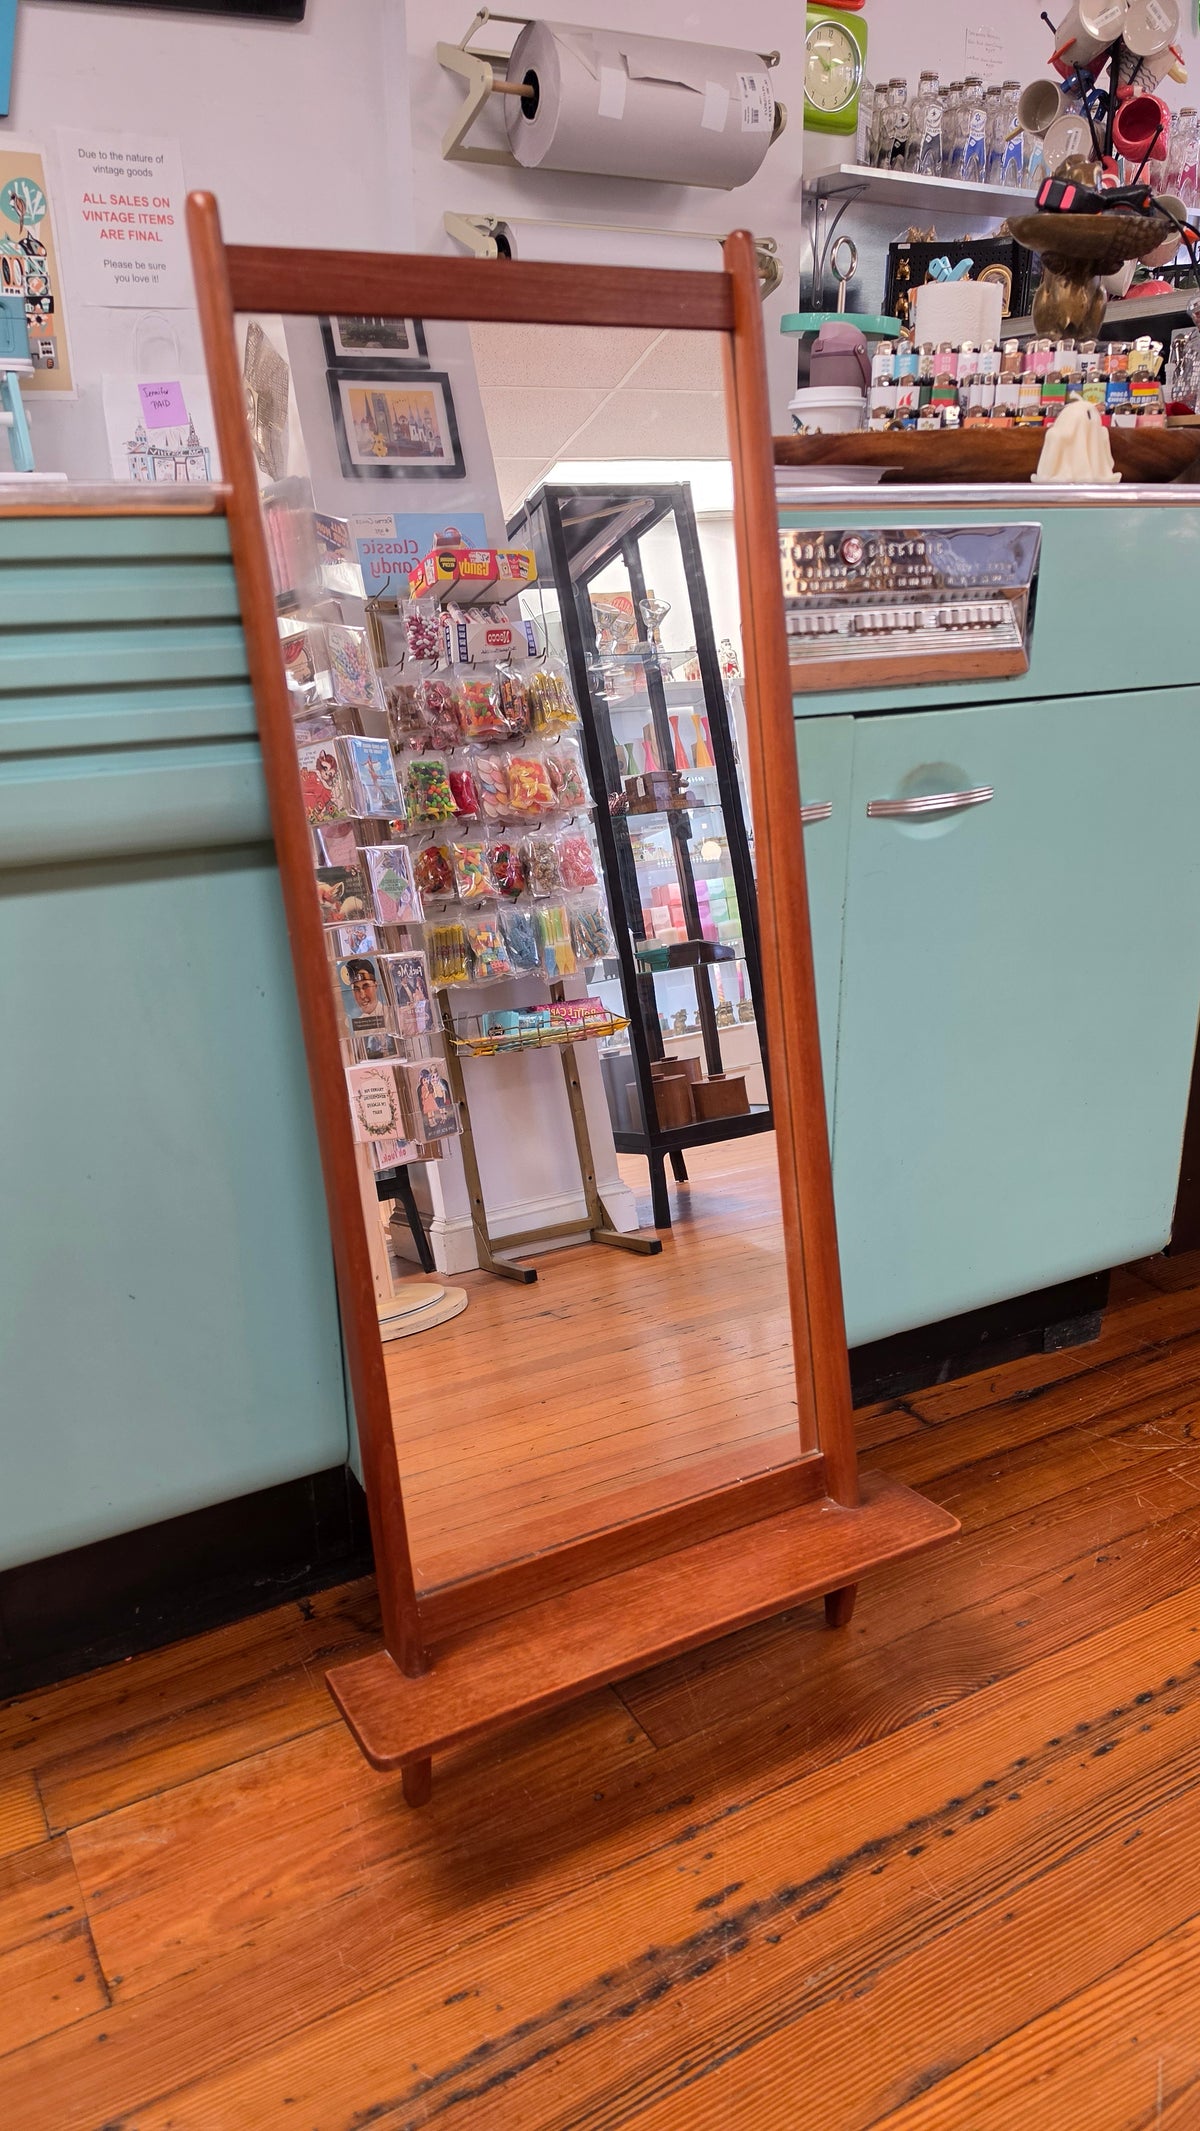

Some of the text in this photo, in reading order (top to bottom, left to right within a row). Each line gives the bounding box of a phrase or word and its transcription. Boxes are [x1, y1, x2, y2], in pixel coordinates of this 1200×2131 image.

[78, 148, 164, 164] Due to the nature of
[93, 165, 153, 178] vintage goods
[83, 193, 170, 208] ALL SALES ON
[82, 210, 175, 226] VINTAGE ITEMS
[100, 229, 163, 242] ARE FINAL
[103, 259, 167, 271] Please be sure
[114, 275, 160, 284] you love it!
